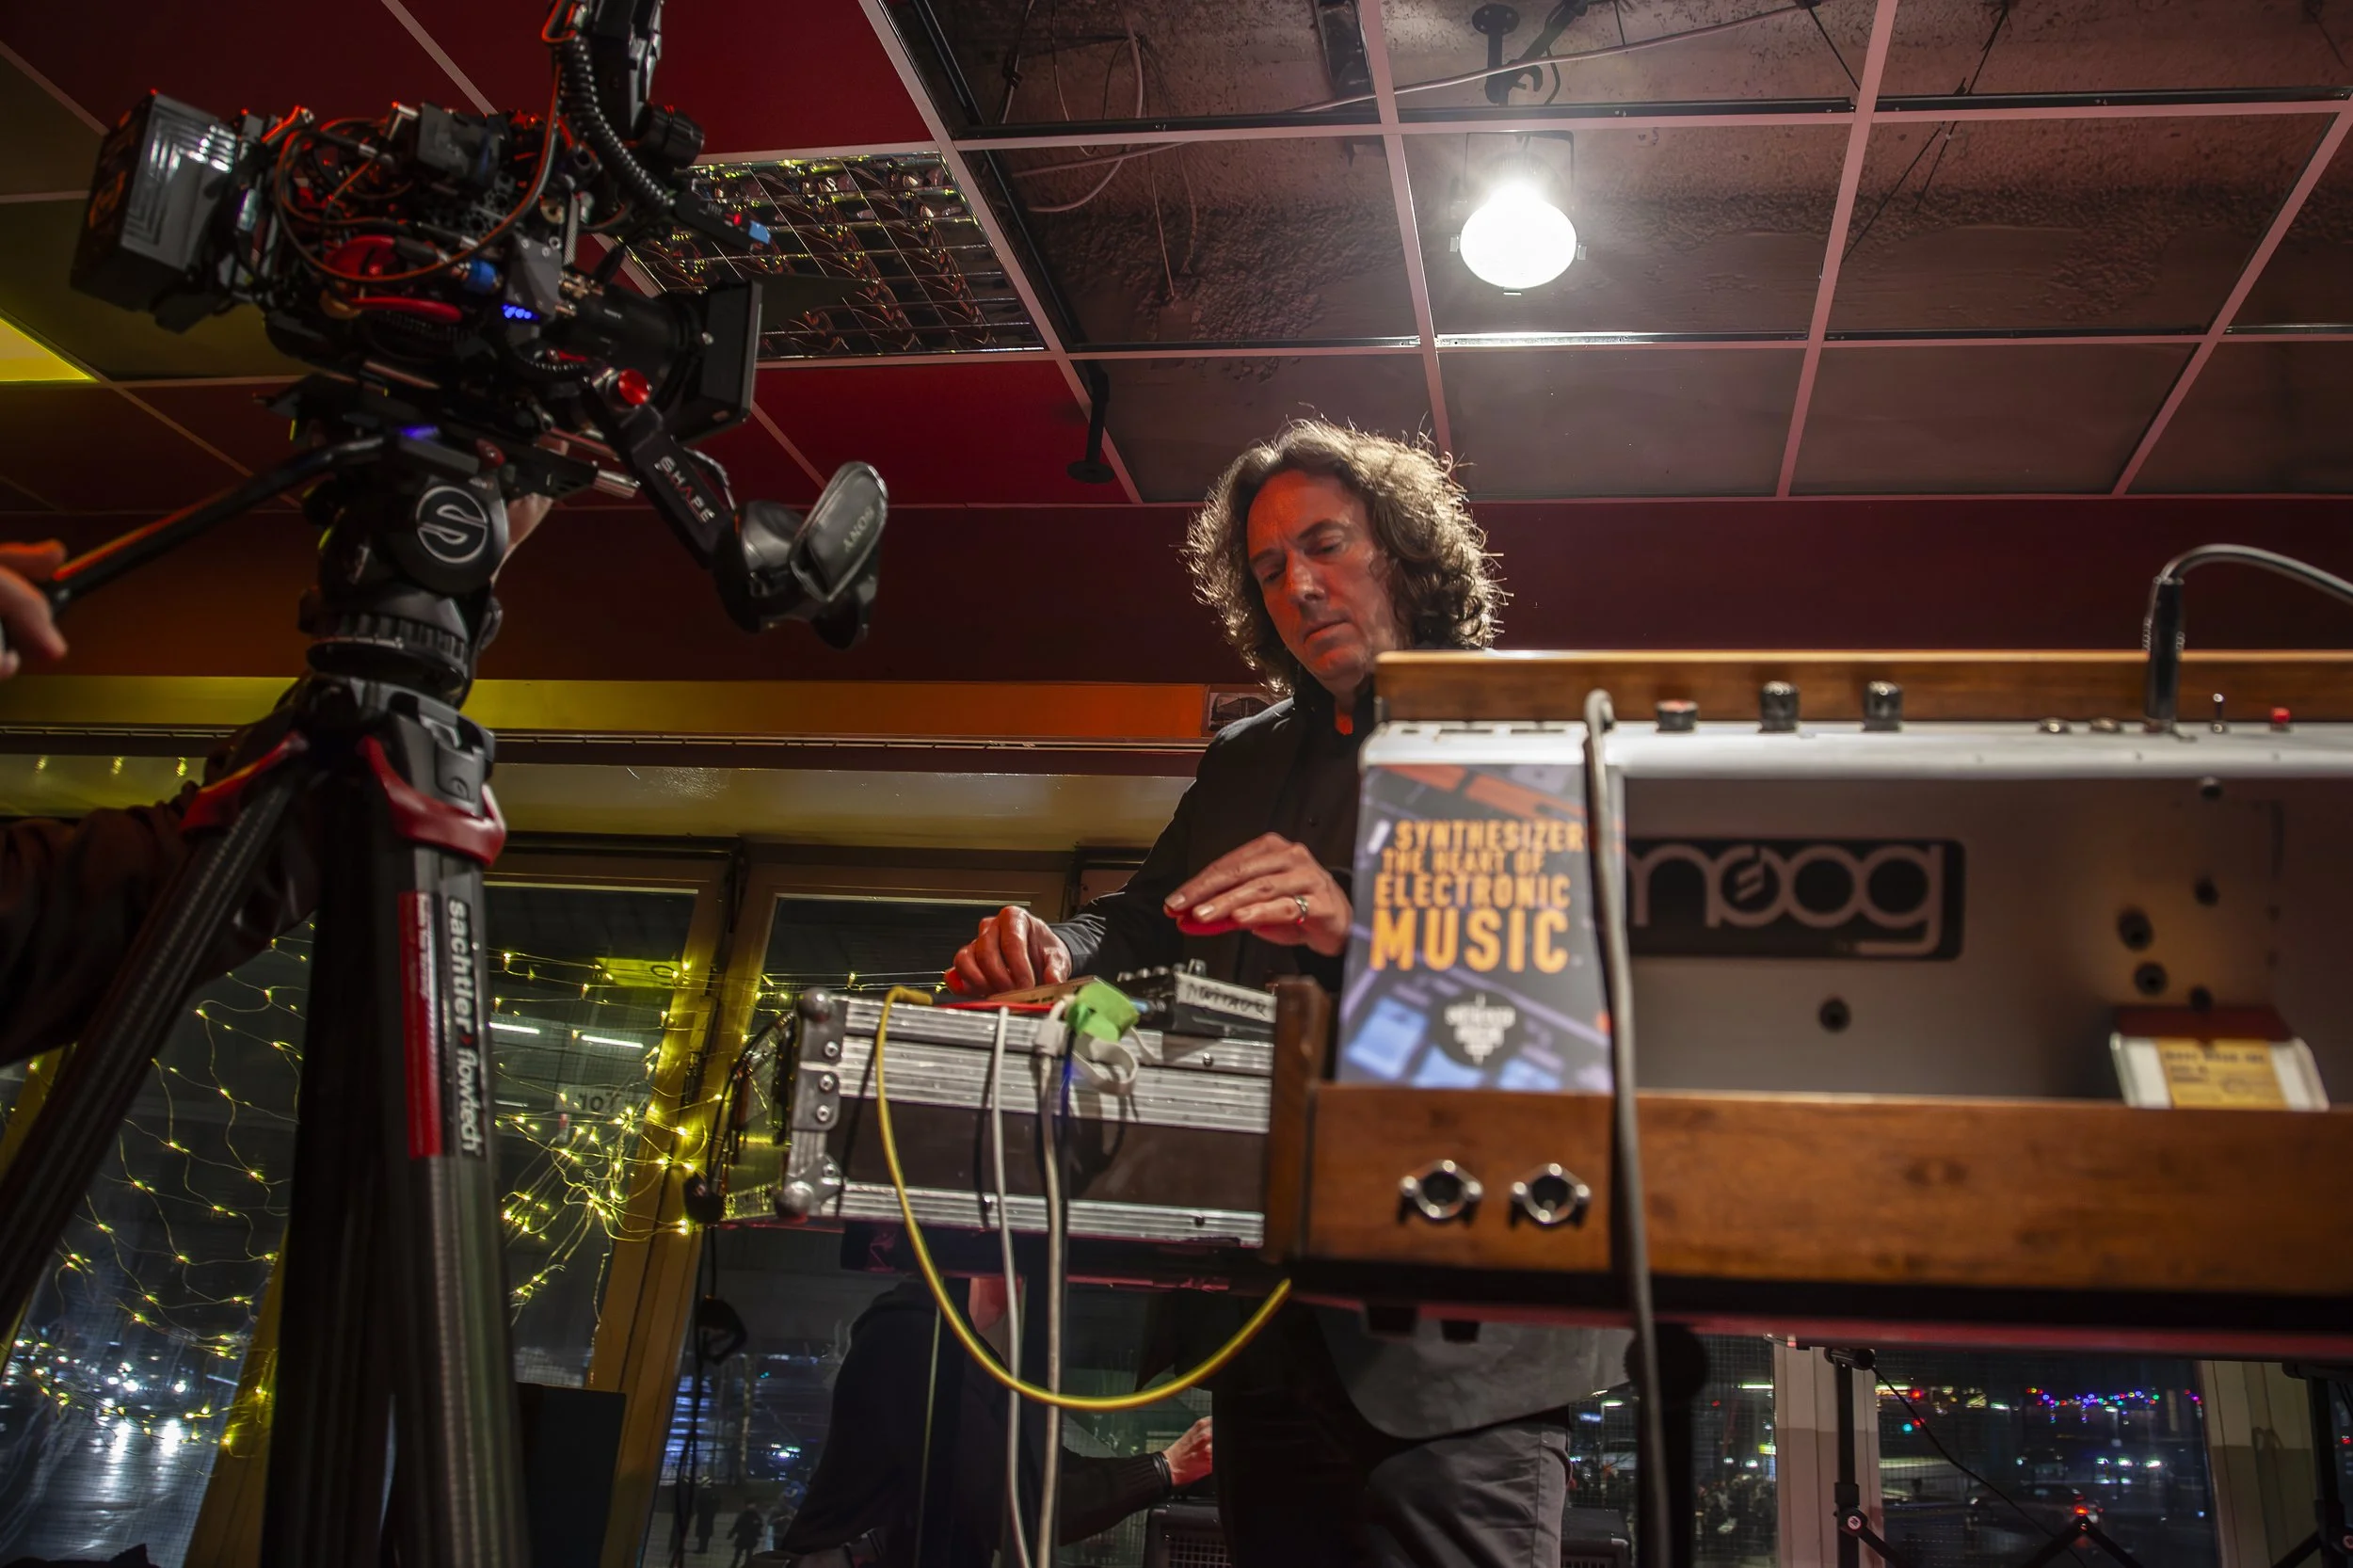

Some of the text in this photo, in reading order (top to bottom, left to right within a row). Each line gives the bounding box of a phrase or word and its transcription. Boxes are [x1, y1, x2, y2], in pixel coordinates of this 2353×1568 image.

[654, 456, 715, 522] SHAPE
[842, 505, 875, 553] SONY
[1395, 819, 1585, 852] SYNTHESIZER
[1381, 848, 1548, 875] THE HEART OF
[1373, 872, 1572, 910] ELECTRONIC
[1369, 906, 1570, 974] MUSIC
[448, 899, 484, 1156] sachtler flowtech
